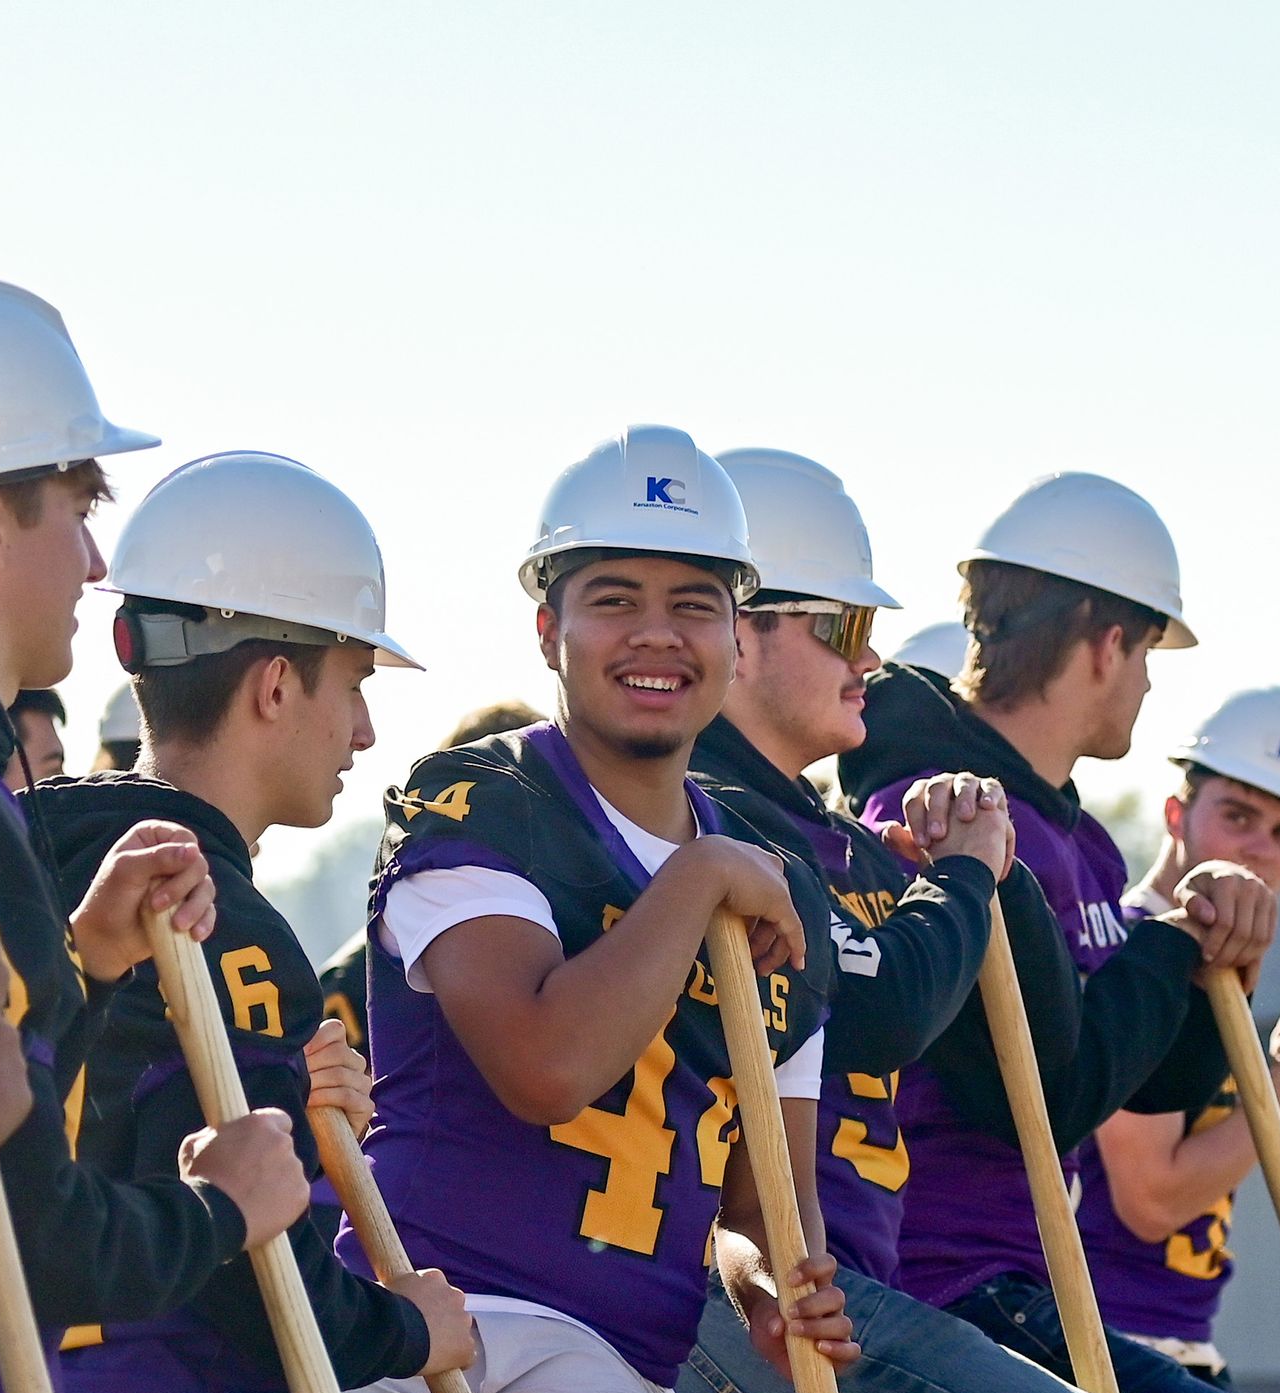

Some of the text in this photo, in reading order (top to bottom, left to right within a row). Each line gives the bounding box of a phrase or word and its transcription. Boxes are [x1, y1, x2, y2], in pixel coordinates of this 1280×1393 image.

[646, 476, 686, 505] KC
[663, 503, 699, 515] Corporation
[219, 944, 285, 1038] 6
